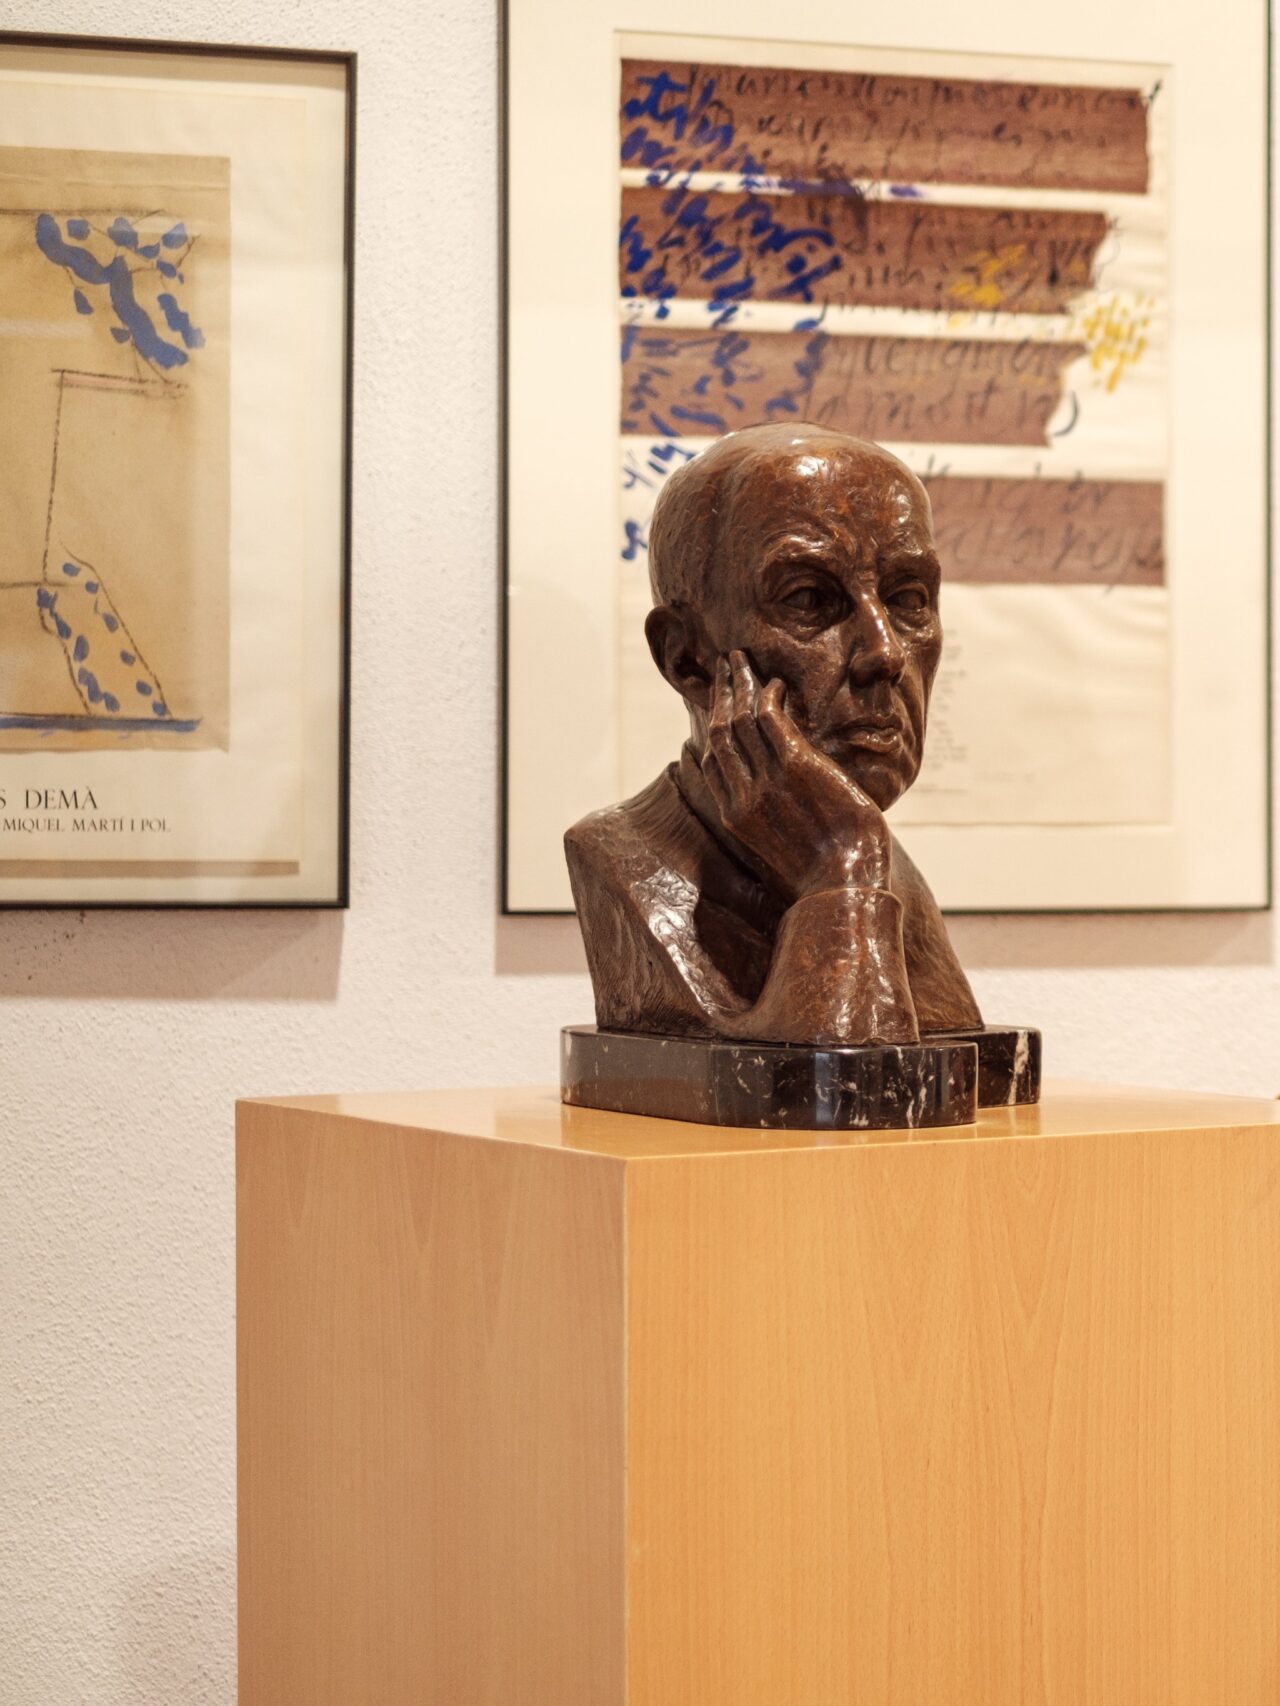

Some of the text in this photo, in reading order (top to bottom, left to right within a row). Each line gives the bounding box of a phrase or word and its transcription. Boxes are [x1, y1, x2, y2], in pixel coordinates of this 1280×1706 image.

[24, 785, 98, 810] DEMÀ
[2, 816, 171, 833] MIQUEL MARTÍ I POL
